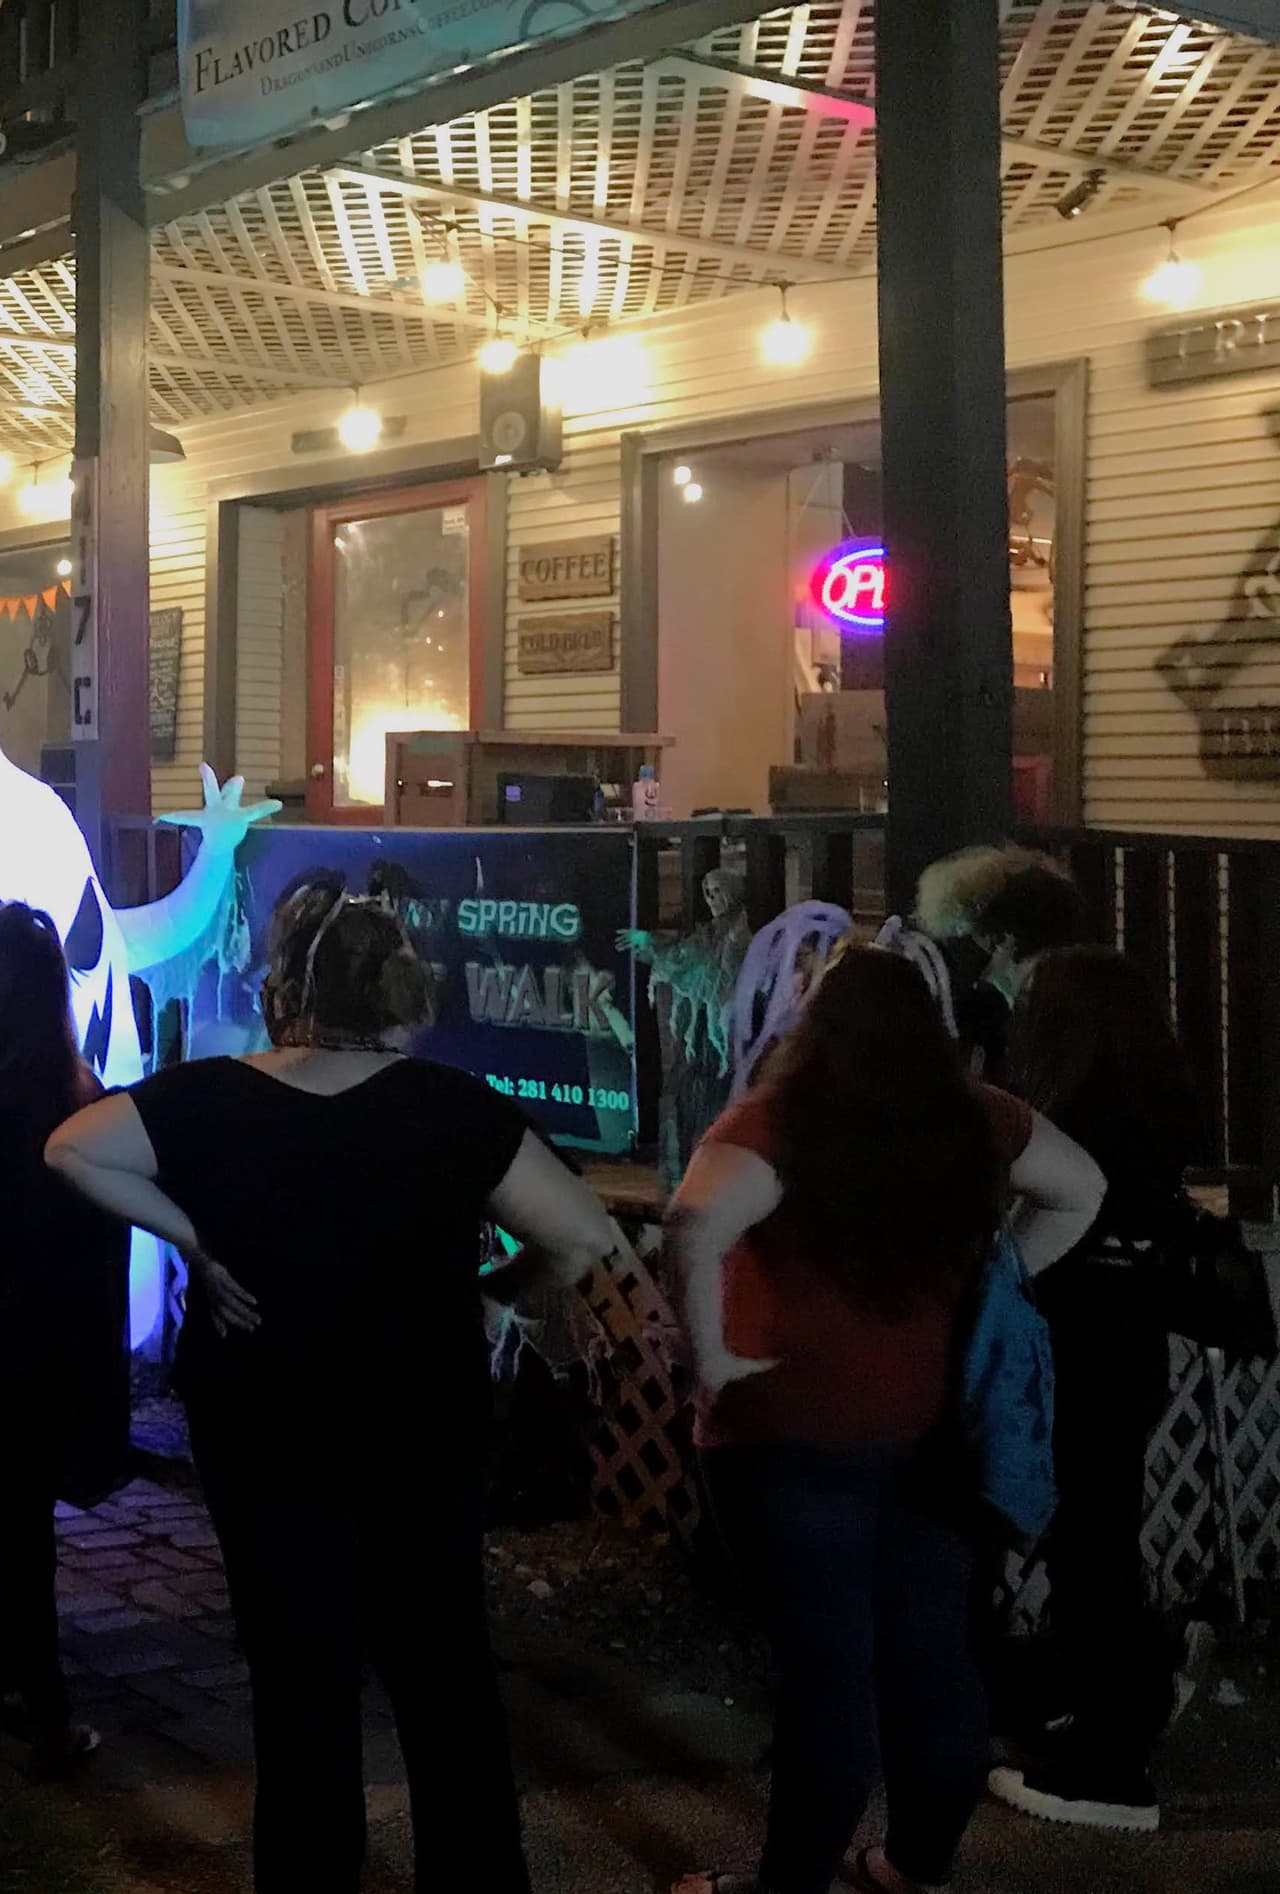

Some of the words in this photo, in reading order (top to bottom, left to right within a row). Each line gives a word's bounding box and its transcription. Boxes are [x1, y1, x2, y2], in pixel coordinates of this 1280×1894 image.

[195, 12, 331, 94] FLAVORED
[521, 553, 606, 584] COFFEE
[458, 900, 579, 936] SPRING
[465, 961, 616, 1036] WALK
[517, 1078, 547, 1100] 281
[552, 1083, 583, 1105] 410
[588, 1088, 629, 1110] 1300
